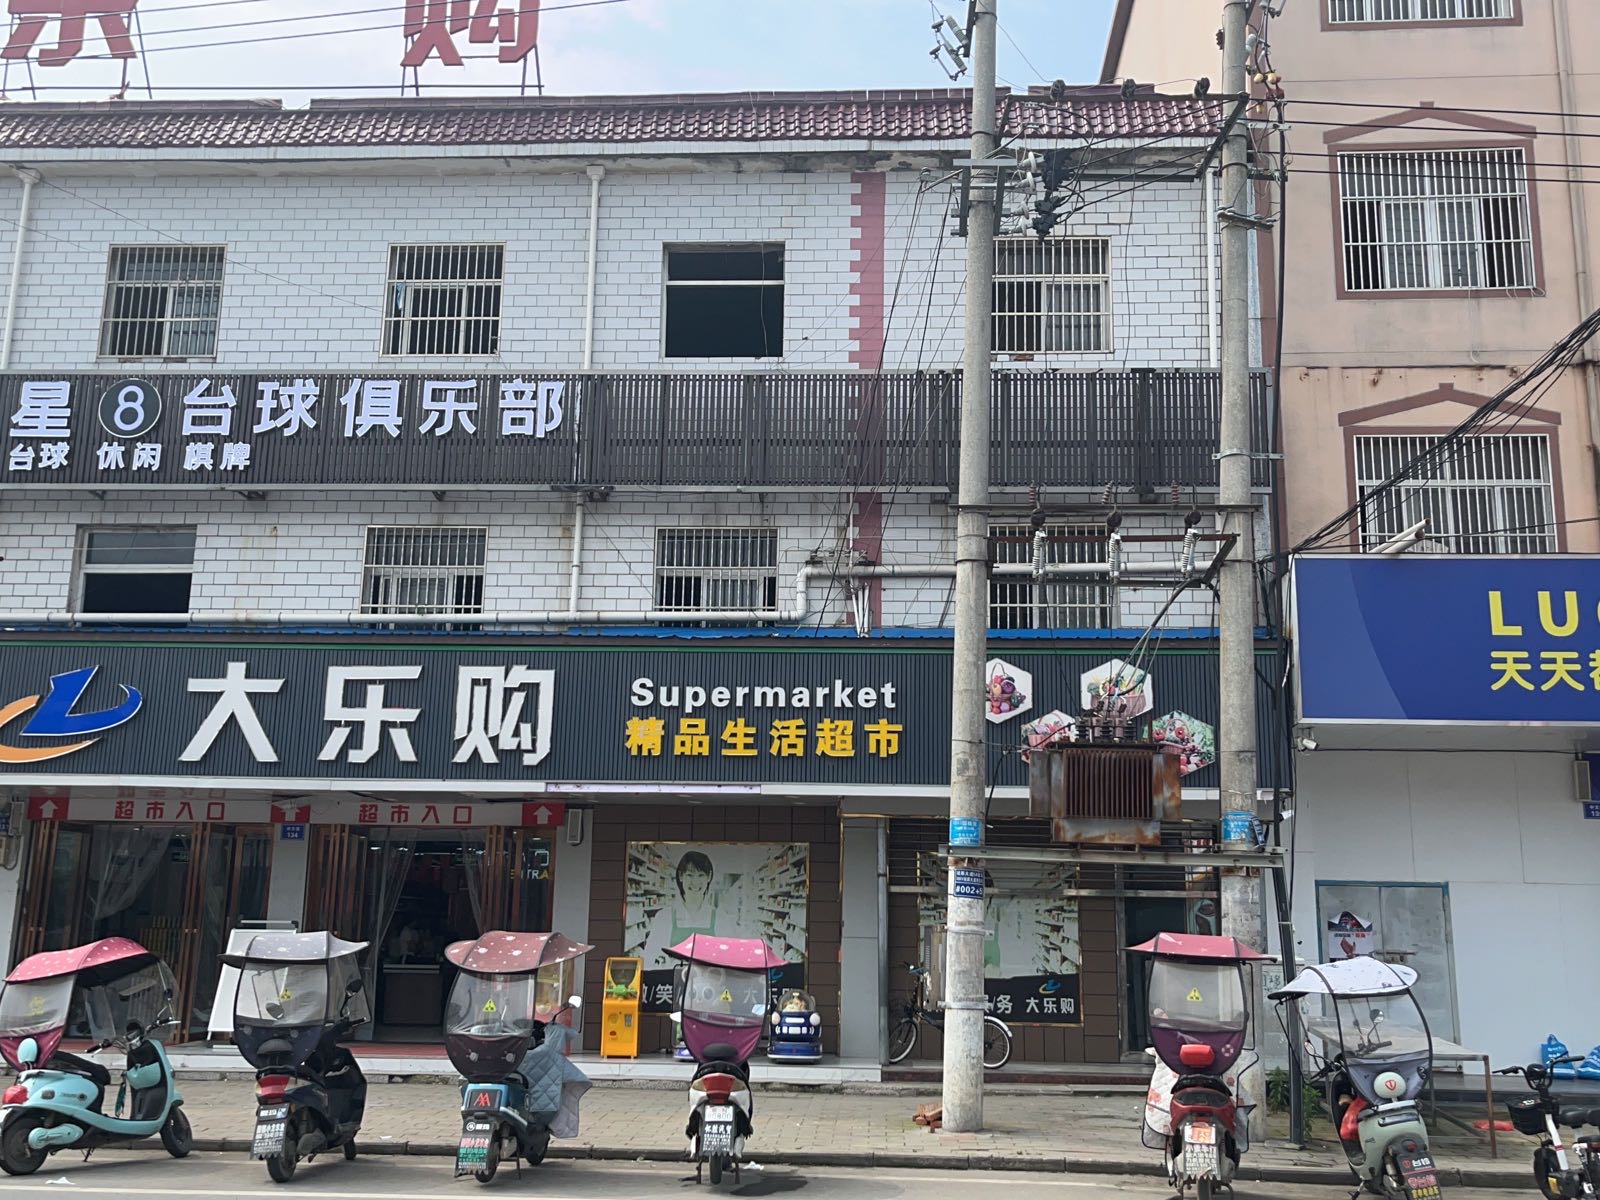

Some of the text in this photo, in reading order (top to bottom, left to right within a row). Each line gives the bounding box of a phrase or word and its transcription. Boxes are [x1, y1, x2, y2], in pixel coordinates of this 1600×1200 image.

[9, 442, 251, 472] 台球 休闲 棋牌
[630, 677, 897, 709] Supermarket
[178, 661, 556, 767] 大乐购
[625, 716, 904, 758] 精品生活超市
[114, 800, 226, 821] 超市入口
[358, 803, 473, 825] 超市入口
[1026, 996, 1075, 1014] 大乐购
